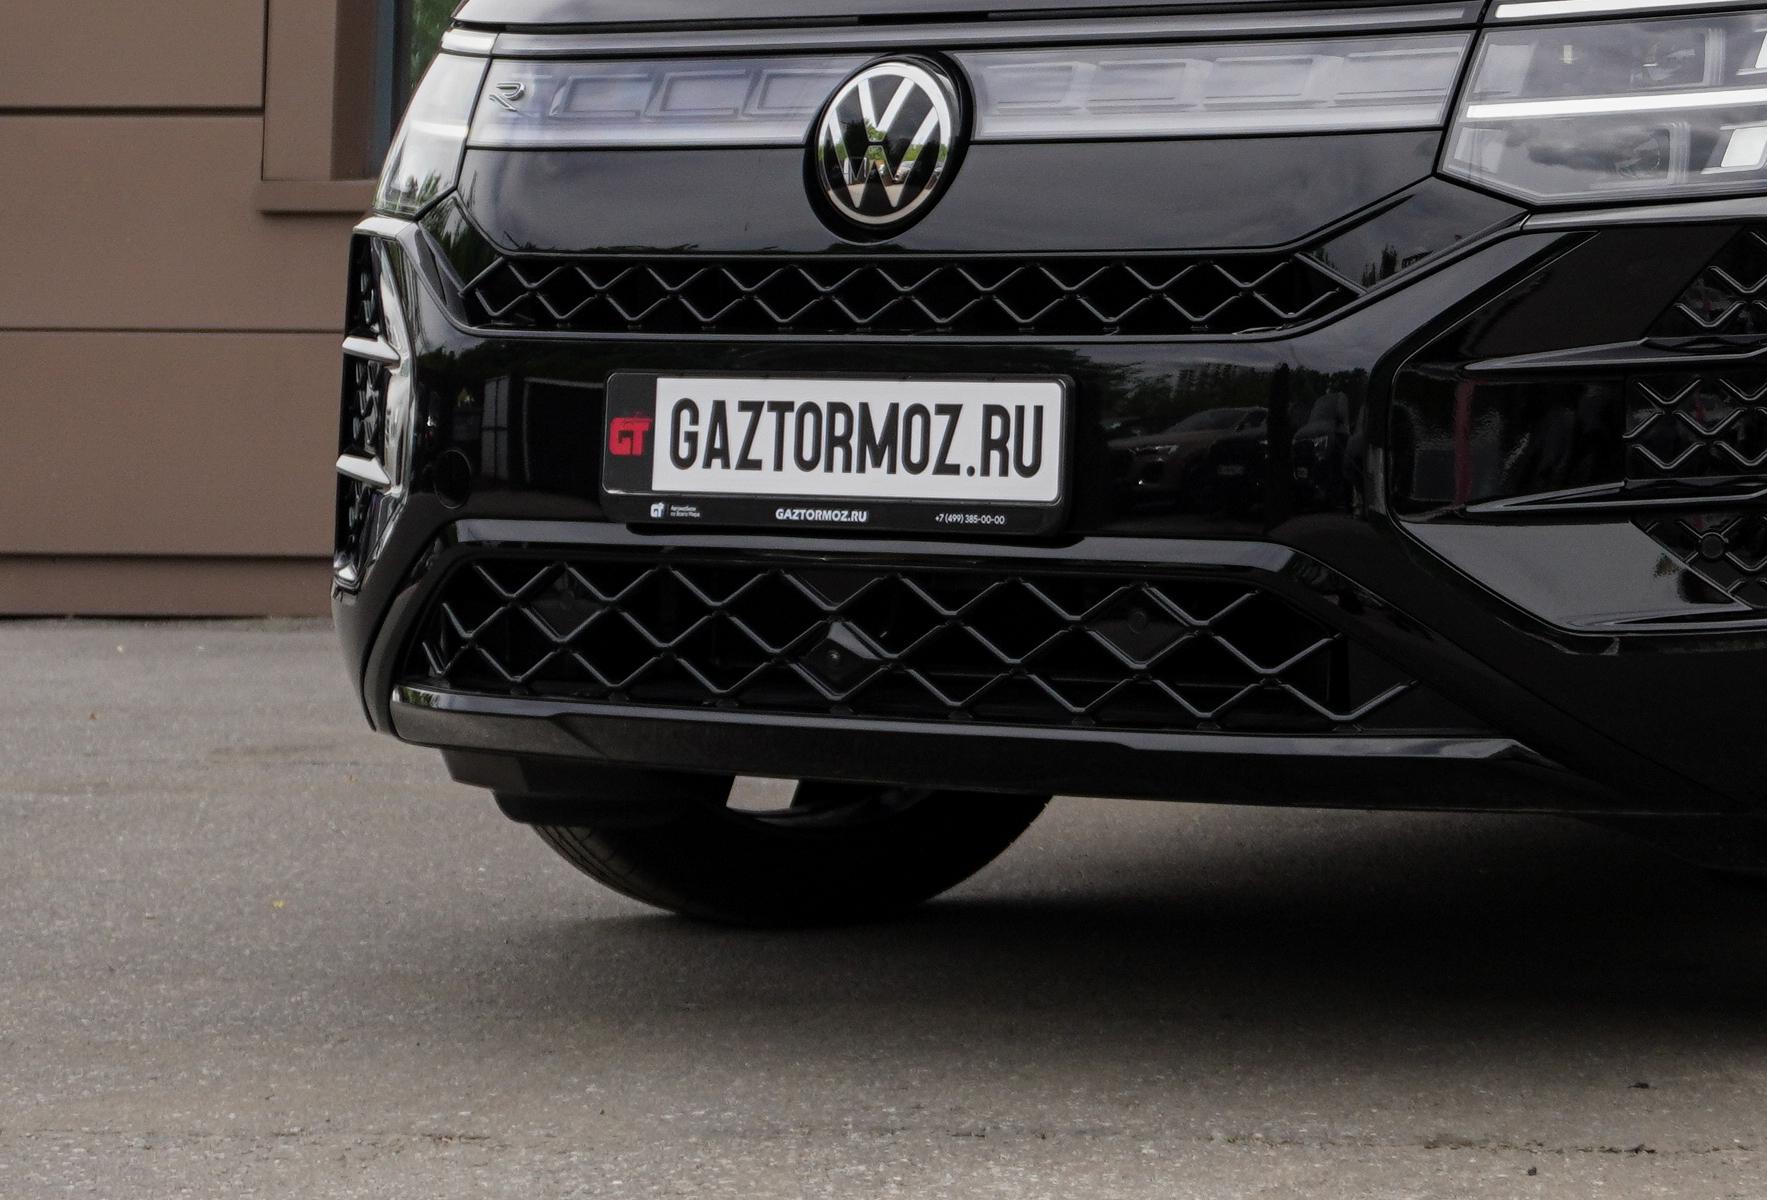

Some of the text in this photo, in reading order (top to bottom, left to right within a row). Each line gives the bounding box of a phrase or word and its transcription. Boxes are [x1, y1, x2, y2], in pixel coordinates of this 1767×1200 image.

[608, 416, 652, 456] GT
[669, 397, 1044, 479] GAZTORMOZ.RU
[775, 507, 868, 523] GAZTORMOZ.RU
[935, 513, 1005, 525] +7 (499) 385-00-00
